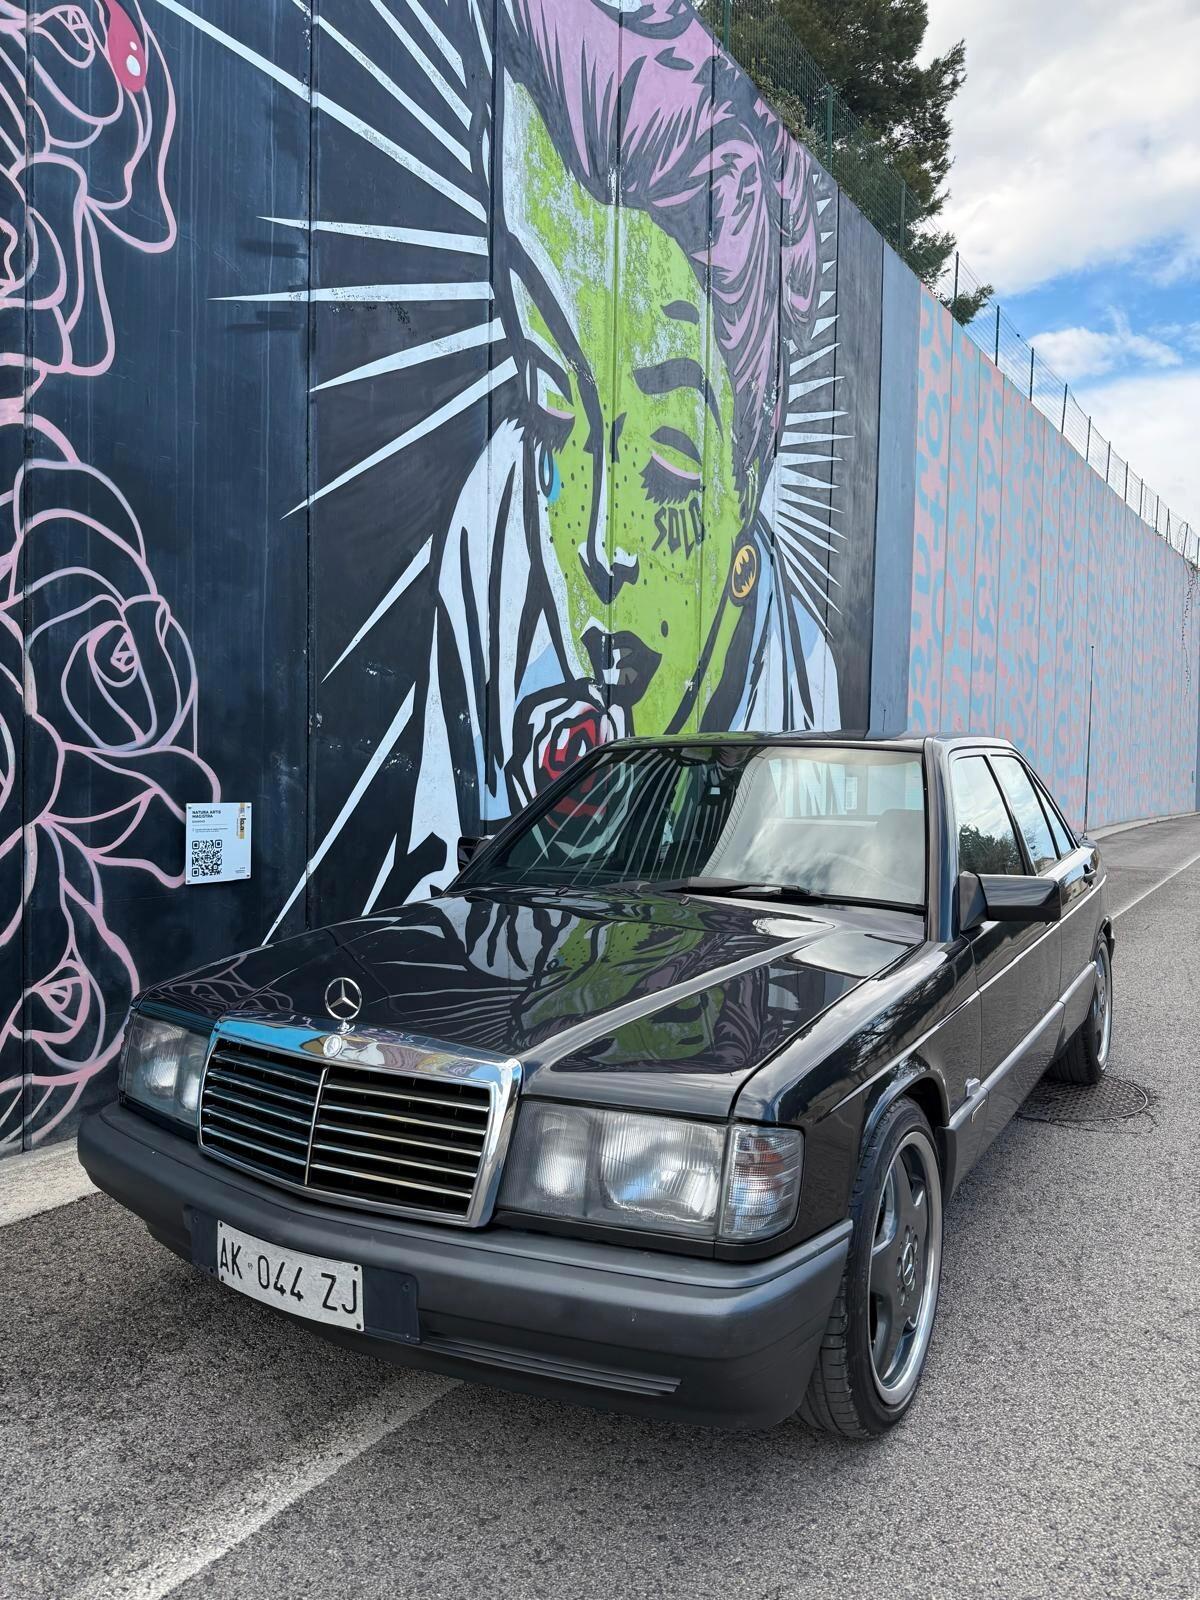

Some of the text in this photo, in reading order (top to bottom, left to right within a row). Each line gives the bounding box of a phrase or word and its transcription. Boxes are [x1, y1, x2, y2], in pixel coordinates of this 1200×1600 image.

[219, 1237, 357, 1314] AK 044 ZJ
